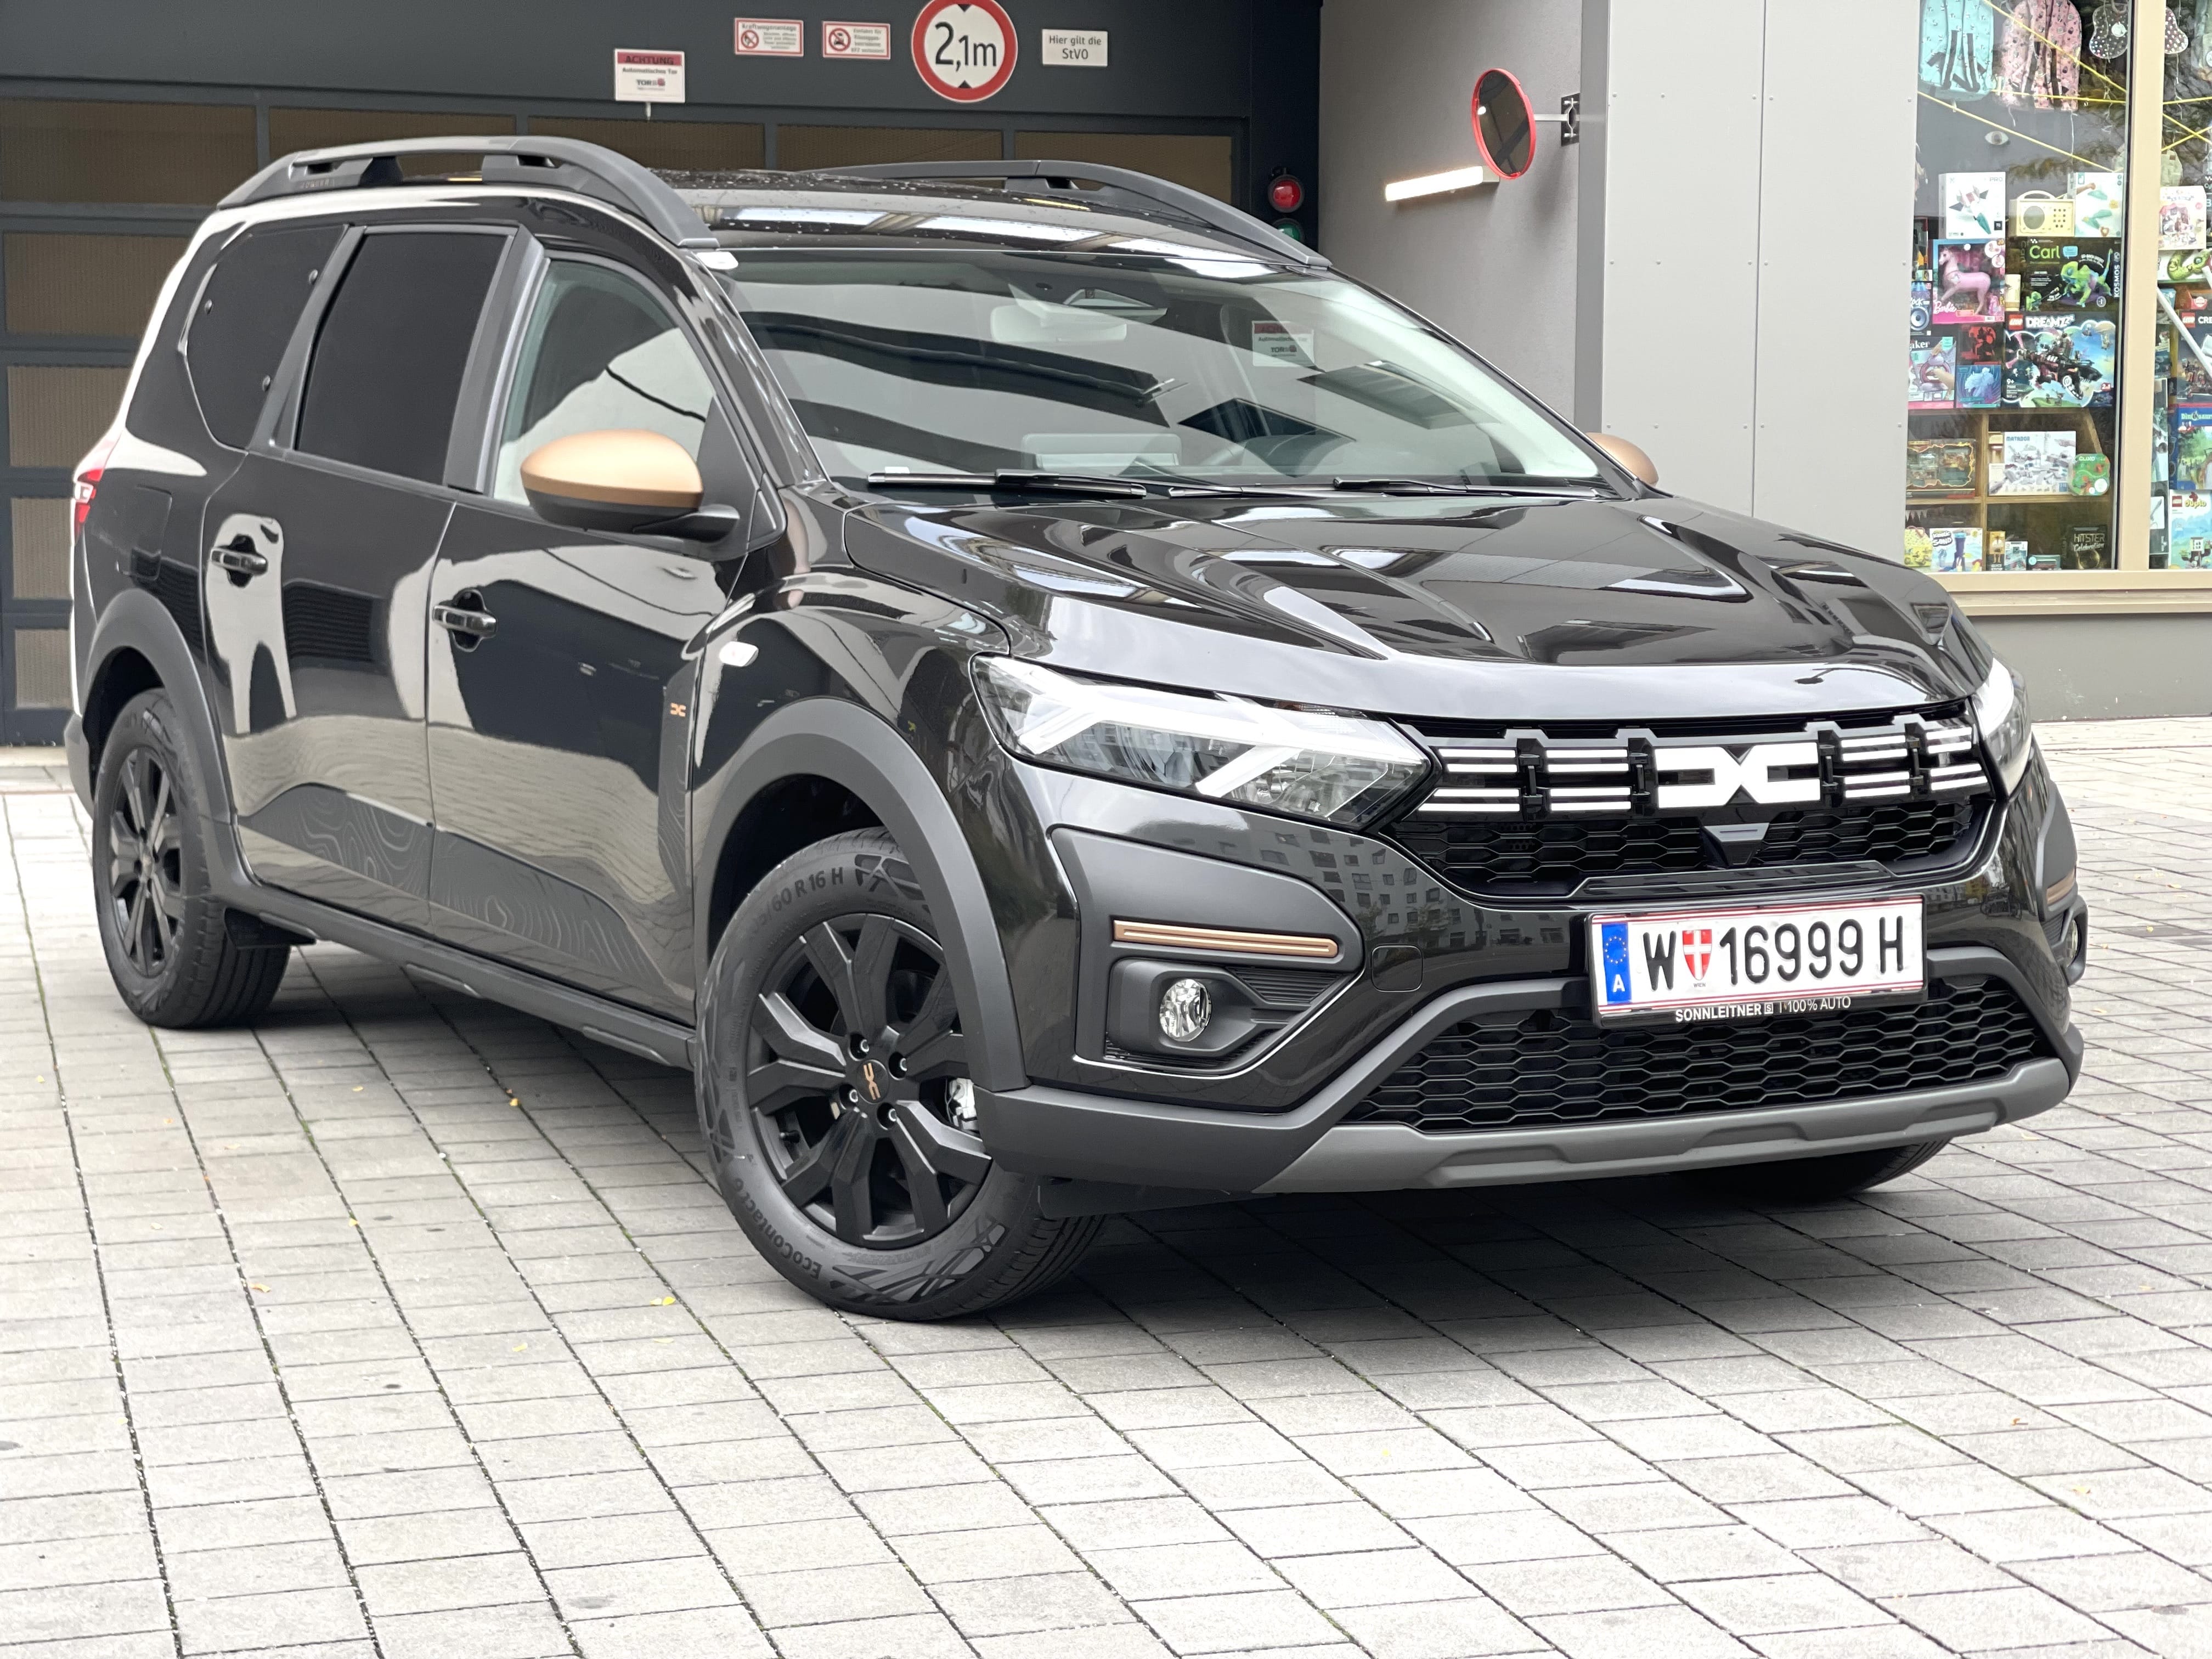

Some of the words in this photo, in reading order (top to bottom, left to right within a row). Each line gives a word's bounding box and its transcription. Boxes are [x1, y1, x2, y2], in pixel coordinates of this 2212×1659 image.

[935, 22, 997, 71] 2,1m
[1049, 35, 1068, 45] Hier
[1070, 35, 1085, 46] gilt
[1088, 36, 1102, 45] die
[624, 55, 674, 65] ACHTUNG
[1062, 48, 1088, 60] StVO
[2030, 245, 2061, 259] Carl
[1933, 301, 1957, 314] Barbie
[771, 888, 792, 912] 60
[832, 867, 843, 885] H
[1643, 930, 1677, 991] W
[1719, 918, 1863, 985] 16999
[1879, 915, 1903, 974] H
[1612, 974, 1626, 992] A
[1675, 1004, 1762, 1022] SONNLEITNER
[1787, 1000, 1818, 1013] 100%
[1820, 996, 1851, 1010] AUTO
